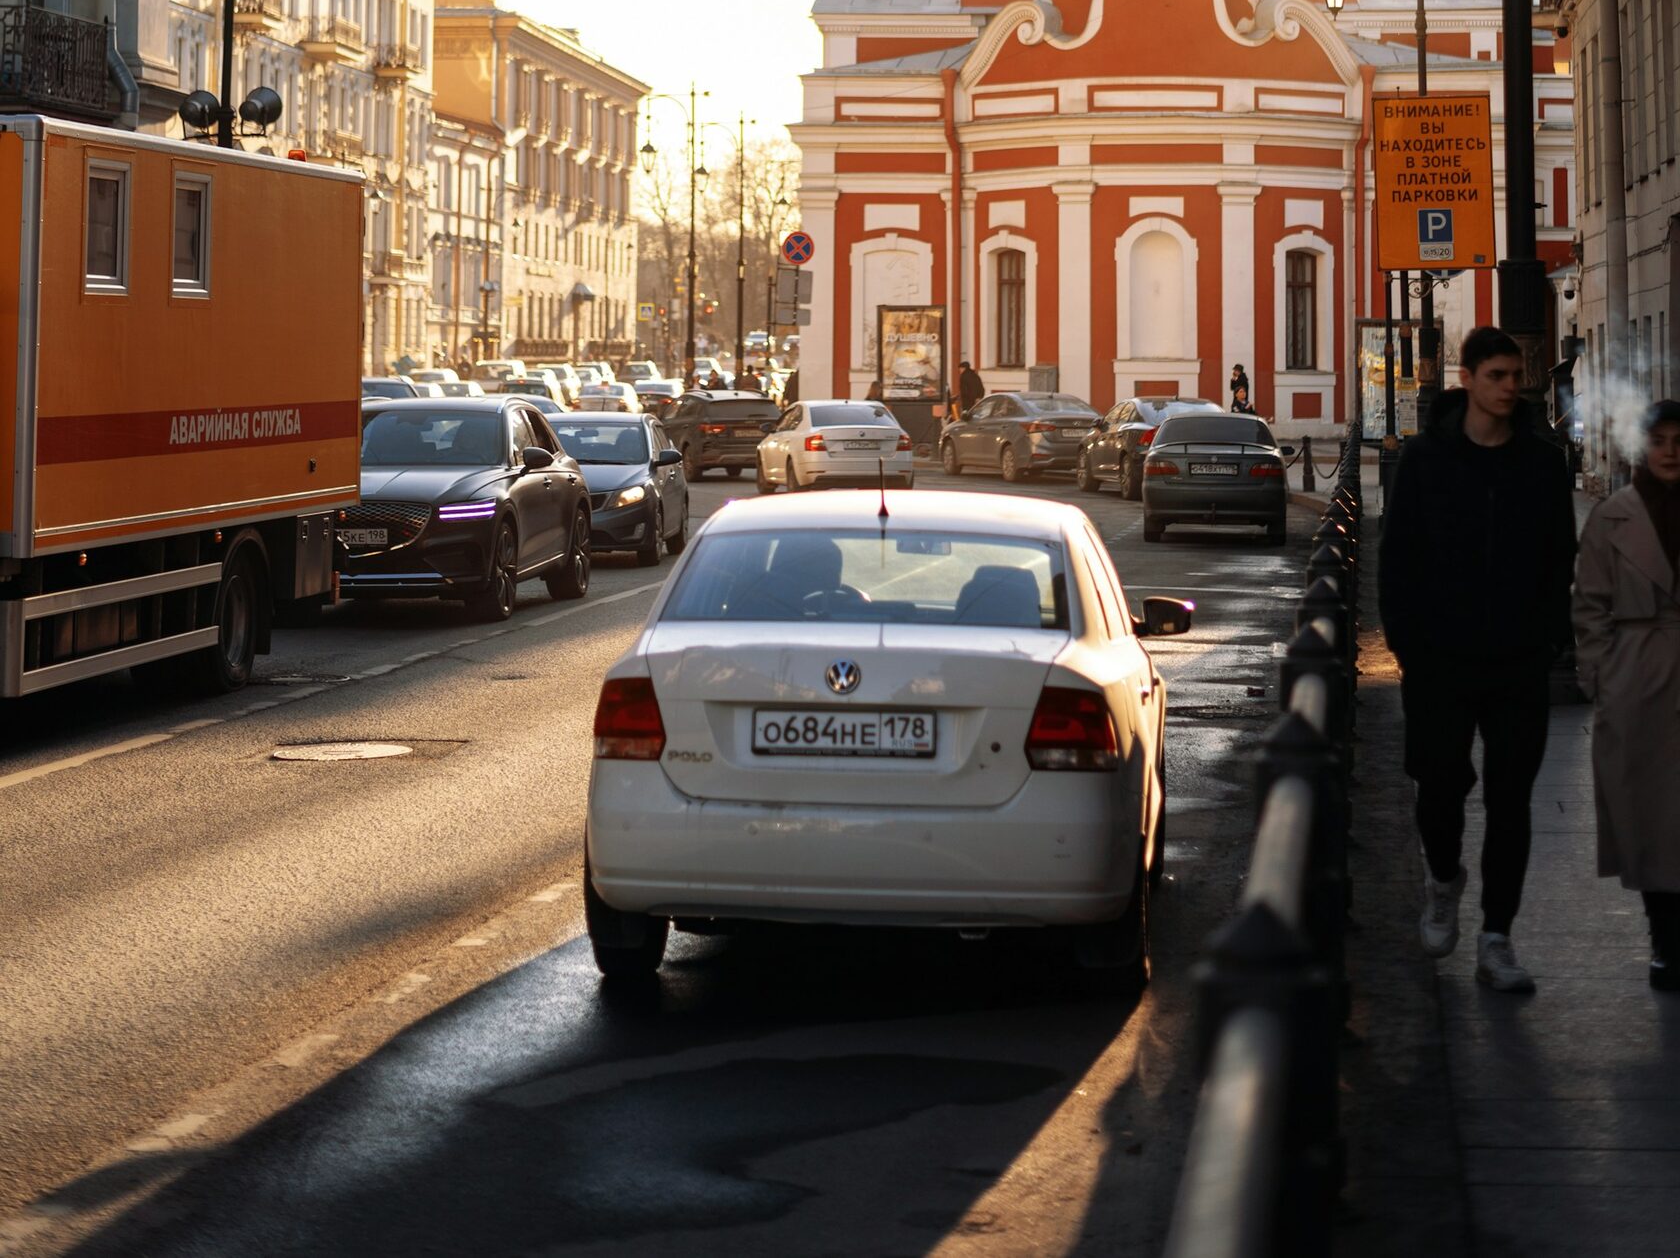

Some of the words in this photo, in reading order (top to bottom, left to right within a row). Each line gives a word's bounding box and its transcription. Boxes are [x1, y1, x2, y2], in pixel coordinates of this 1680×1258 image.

[1384, 104, 1479, 118] ВНИМАНИЕ!
[1420, 122, 1444, 134] ВЫ
[1380, 138, 1486, 153] НАХОДИТЕСЬ
[1406, 156, 1415, 168] В
[1421, 155, 1461, 168] ЗОНЕ
[1397, 168, 1471, 185] ПЛАТНОЙ
[1392, 189, 1478, 202] ПАРКОВКИ
[1427, 212, 1447, 239] P
[1439, 248, 1450, 256] 20
[886, 333, 939, 342] ДУШЕВНО
[169, 407, 249, 445] АВАРИЙНАЯ
[252, 408, 301, 438] СЛУЖБА
[368, 530, 385, 539] 198
[884, 716, 926, 739] 178
[668, 750, 713, 763] POLO
